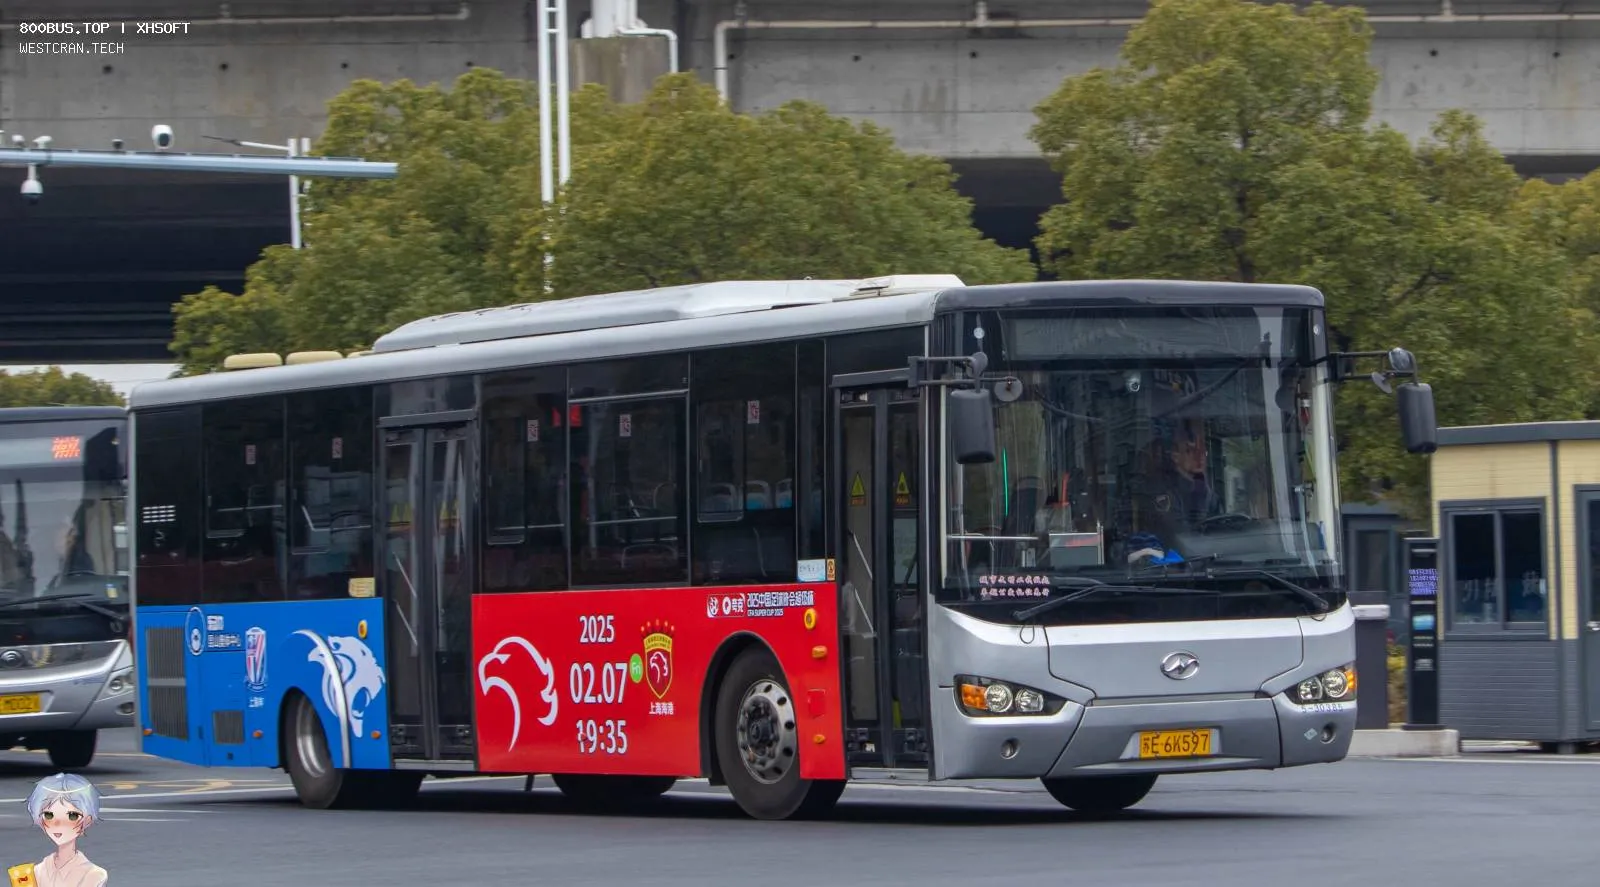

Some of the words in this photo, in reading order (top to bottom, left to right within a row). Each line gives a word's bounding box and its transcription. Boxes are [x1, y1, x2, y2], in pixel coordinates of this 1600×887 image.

[579, 615, 615, 643] 2025
[569, 662, 628, 704] 02.07
[576, 719, 628, 754] 19:35
